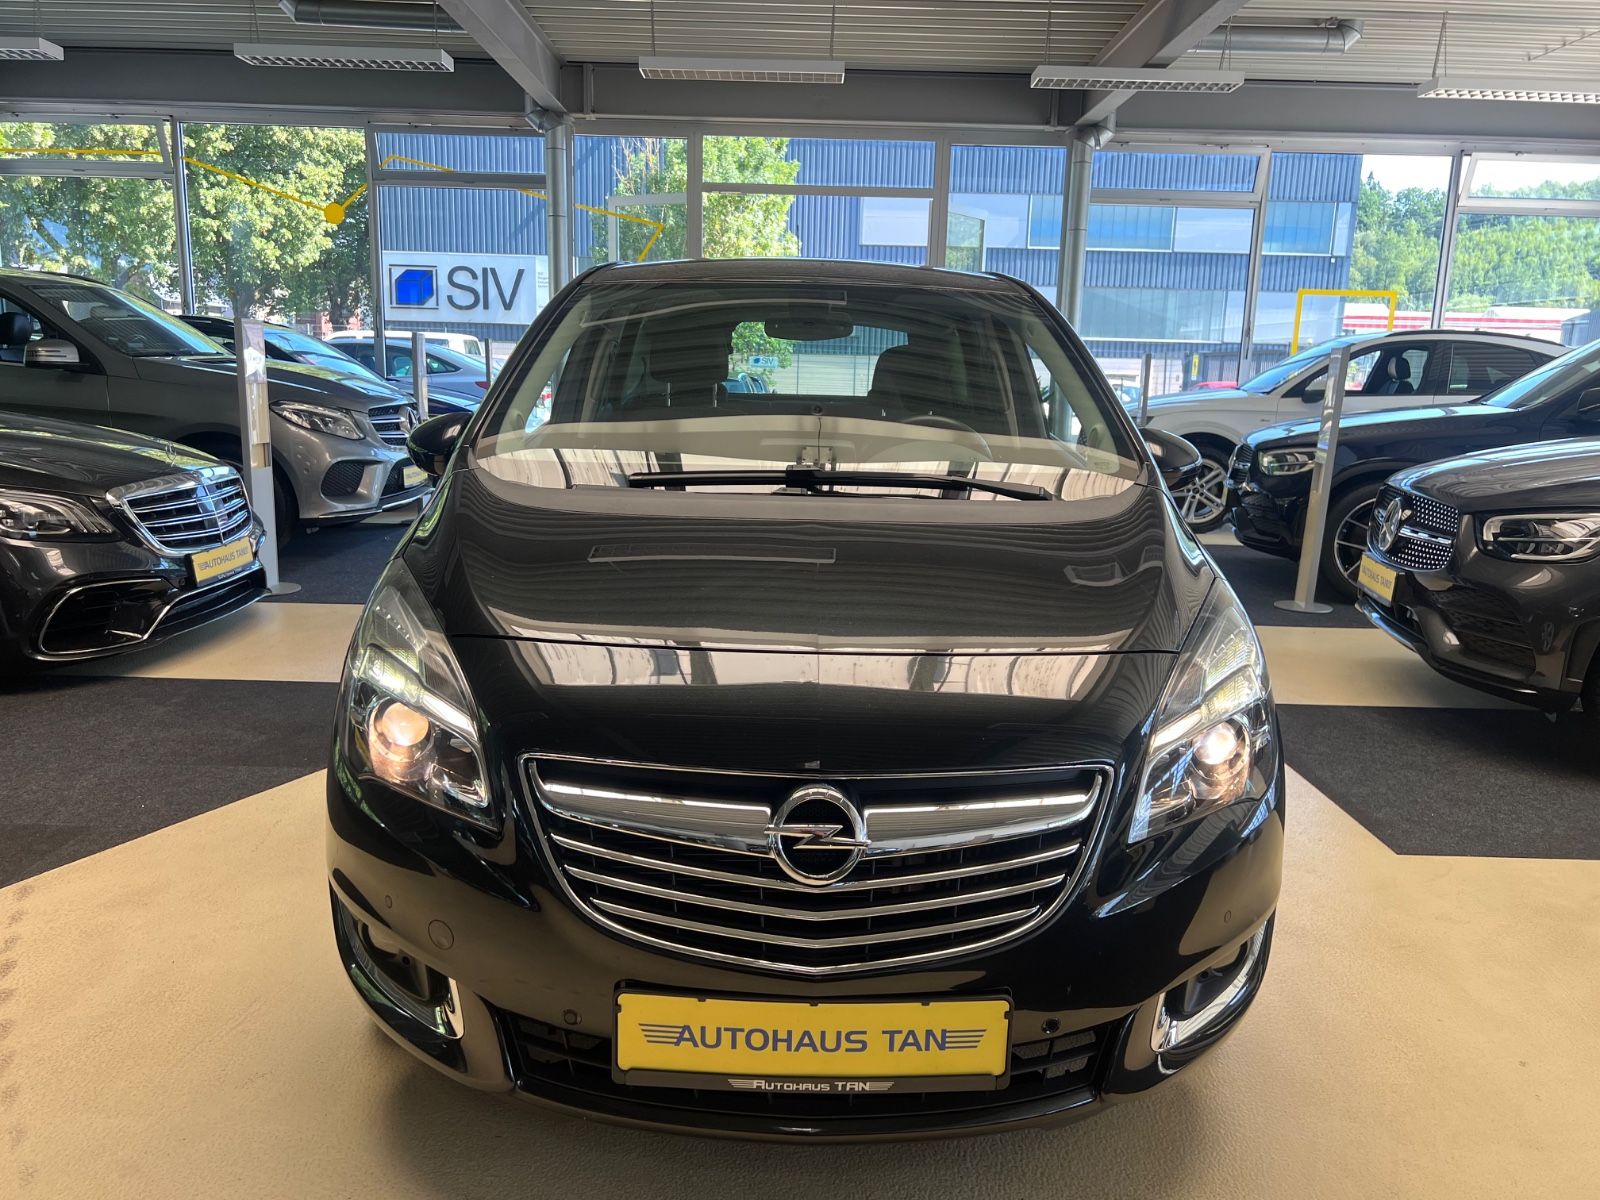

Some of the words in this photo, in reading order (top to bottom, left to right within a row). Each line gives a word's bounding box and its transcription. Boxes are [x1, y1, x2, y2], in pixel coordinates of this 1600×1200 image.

[446, 265, 525, 310] SIV
[674, 1024, 868, 1053] AUTOHAUS
[882, 1029, 947, 1052] TAN
[834, 1081, 870, 1092] TAN
